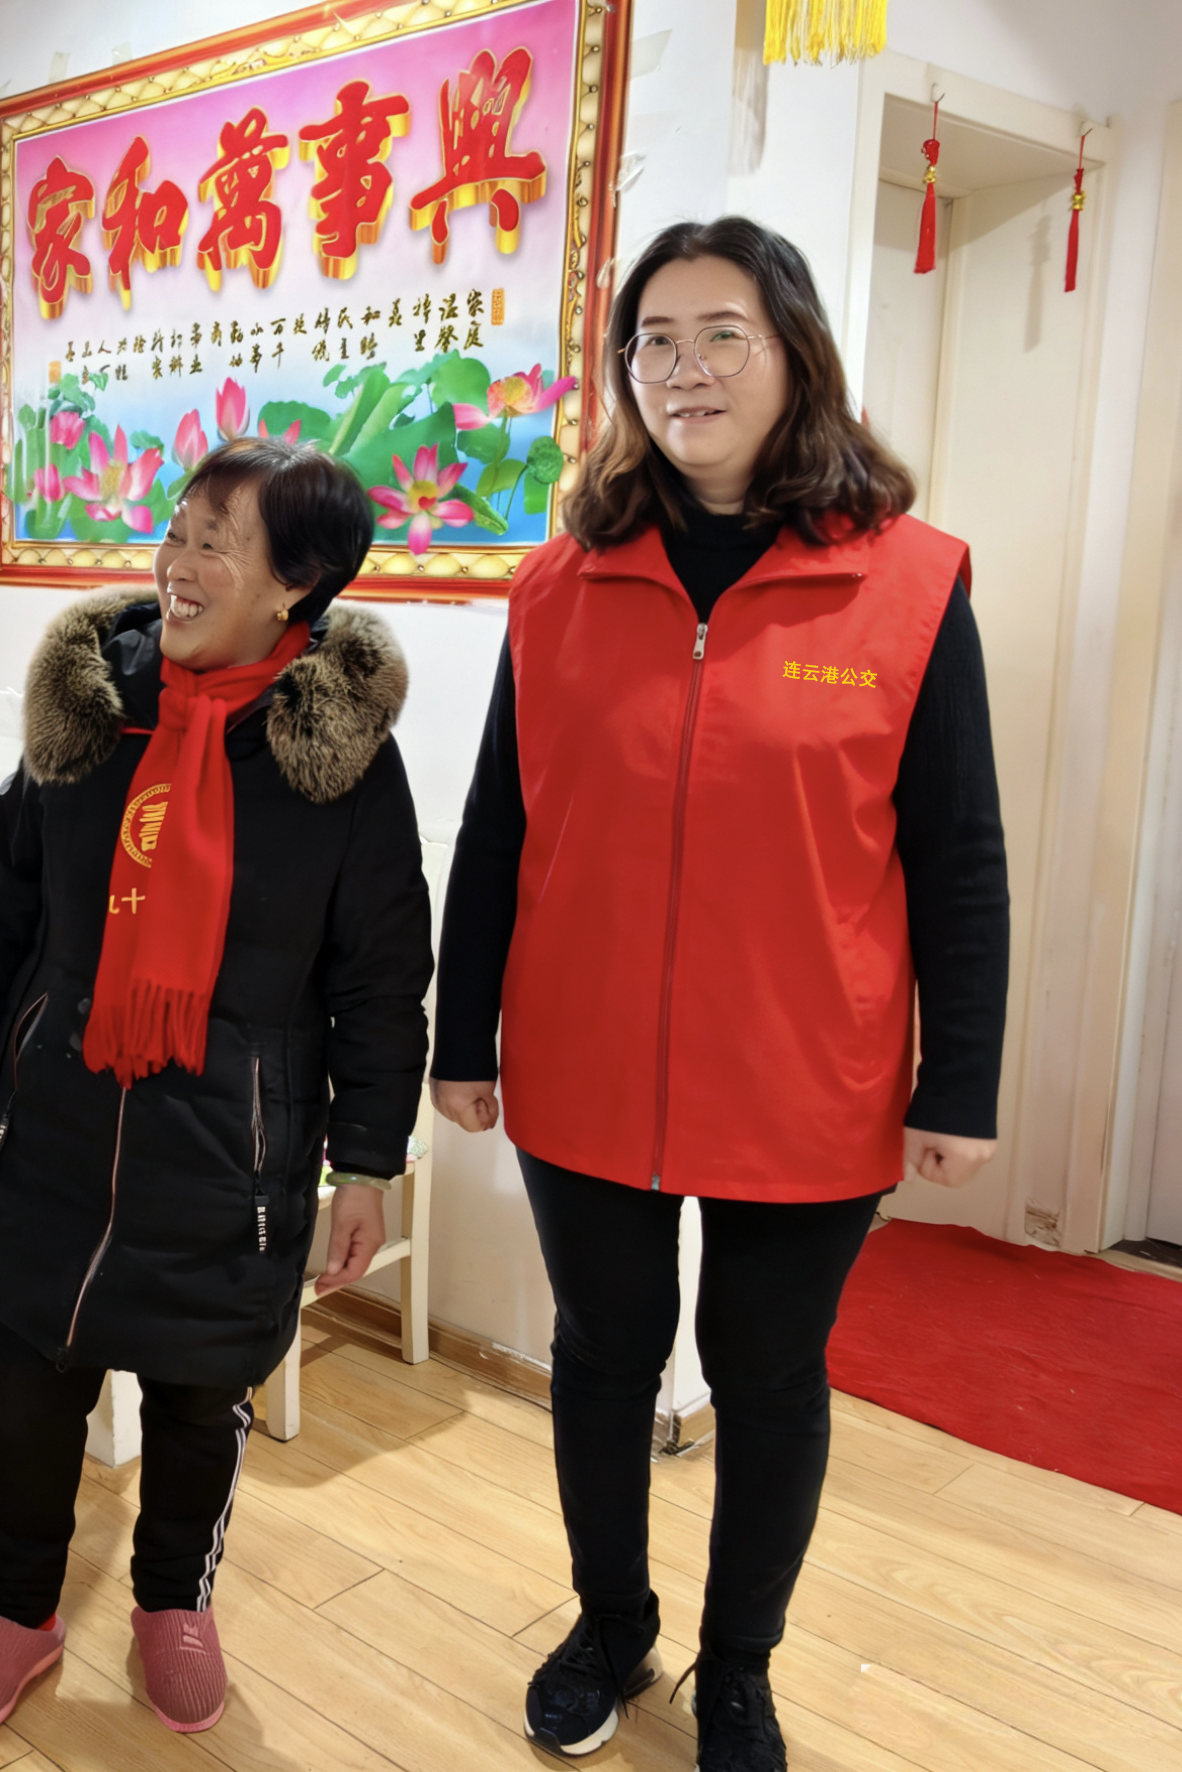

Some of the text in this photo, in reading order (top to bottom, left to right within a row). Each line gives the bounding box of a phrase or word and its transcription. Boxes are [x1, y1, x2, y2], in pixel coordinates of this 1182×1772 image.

[27, 46, 547, 321] 家和萬事興
[782, 660, 878, 689] 连云港公交
